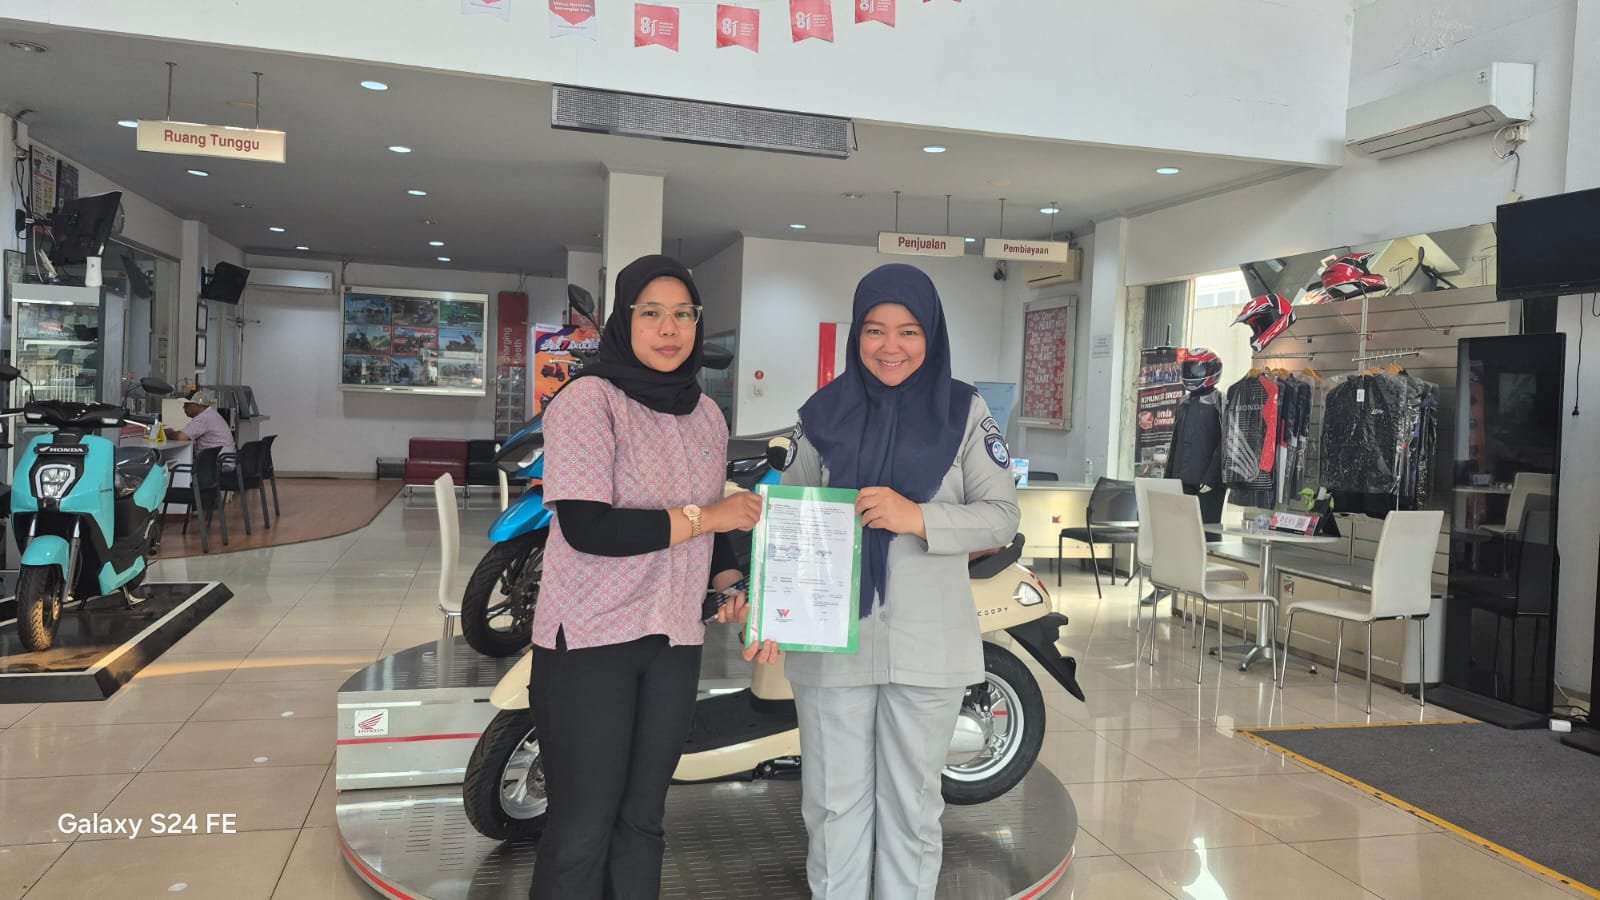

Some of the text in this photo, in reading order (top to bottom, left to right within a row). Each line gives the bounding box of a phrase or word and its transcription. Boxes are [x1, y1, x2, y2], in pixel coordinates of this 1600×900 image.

[164, 129, 260, 152] Ruang Tunggu
[898, 236, 946, 251] Penjualan
[1003, 243, 1049, 255] Pembiayaan
[977, 607, 1009, 617] COOPY
